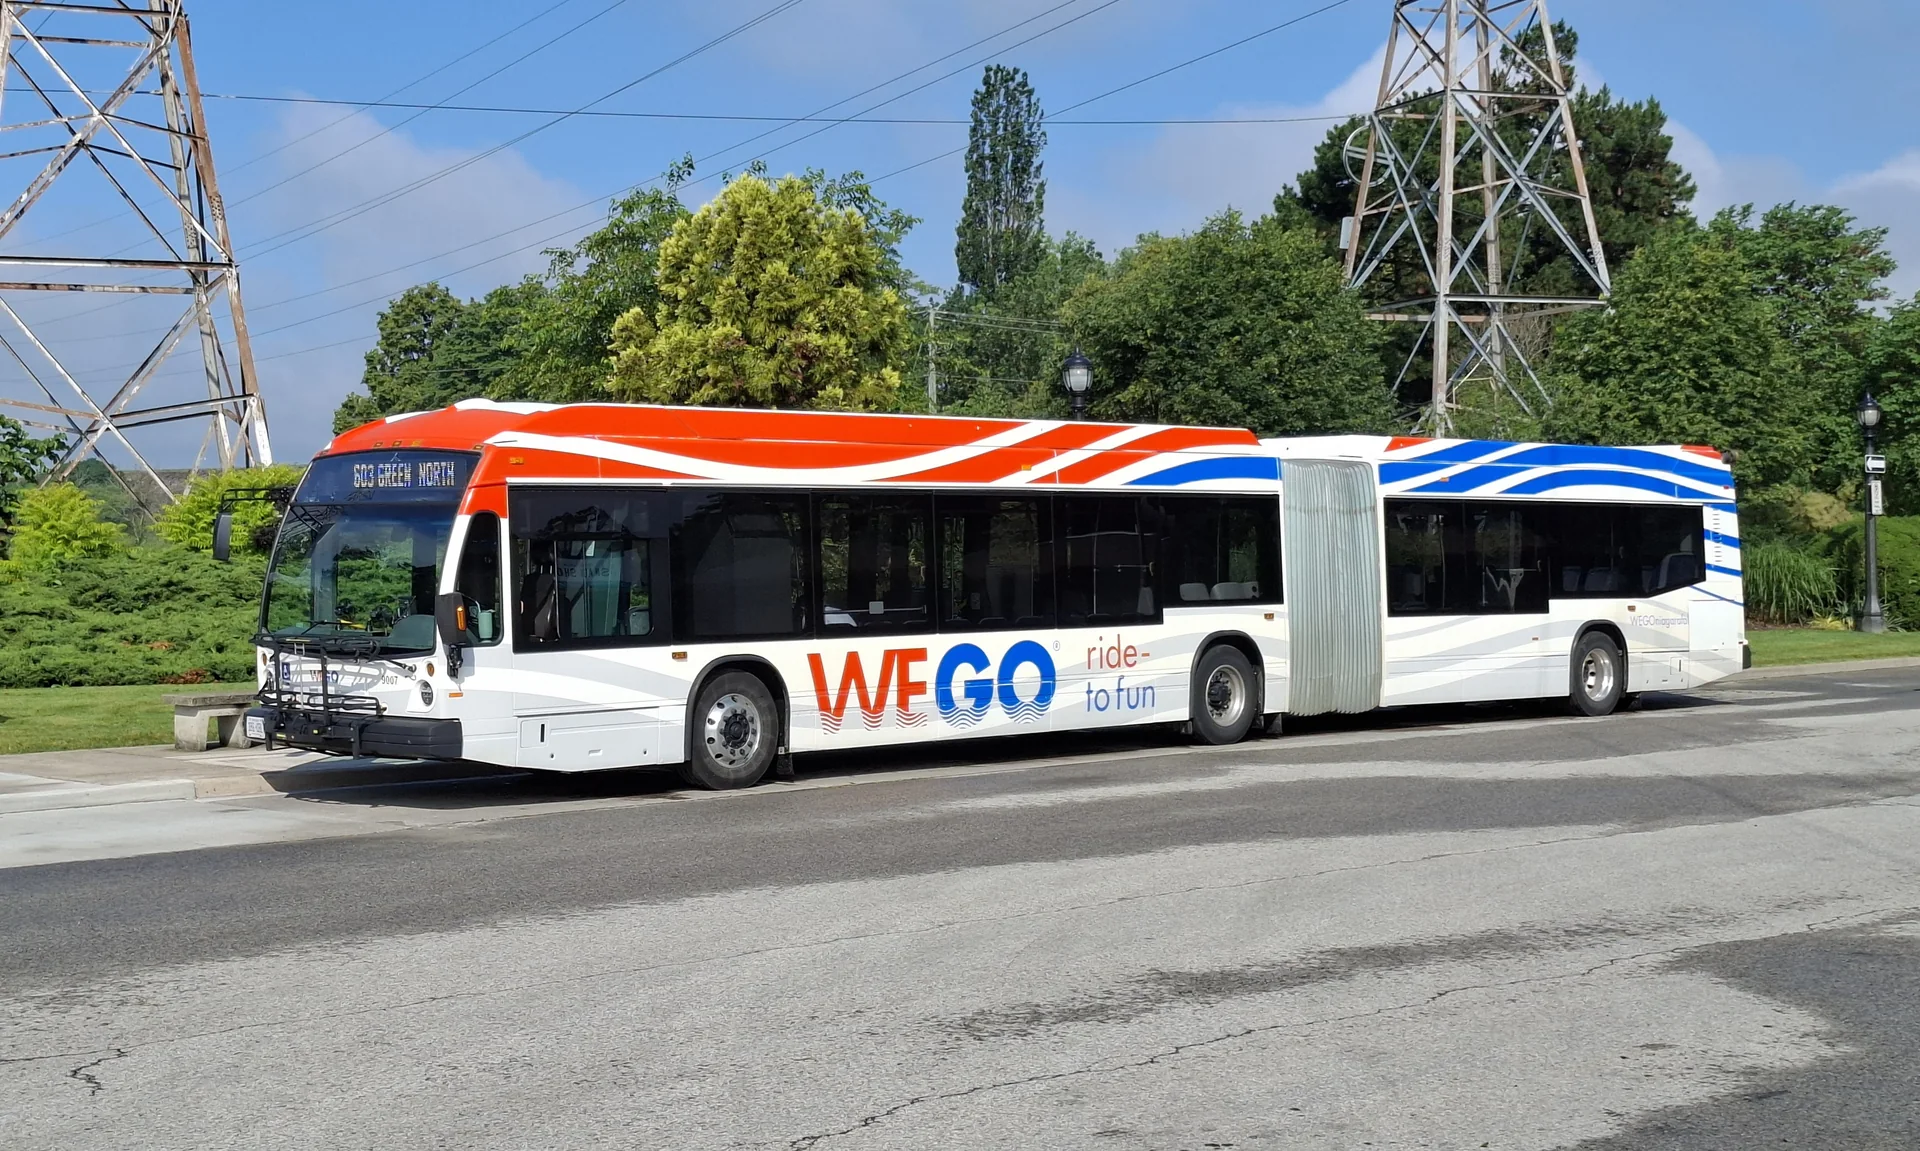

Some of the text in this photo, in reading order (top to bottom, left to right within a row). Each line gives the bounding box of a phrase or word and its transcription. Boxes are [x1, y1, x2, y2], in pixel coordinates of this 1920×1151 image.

[353, 462, 455, 488] 603 GREEN NORTH
[1087, 634, 1151, 670] ride-
[381, 674, 399, 686] 9007
[807, 639, 1057, 735] WEGO
[1085, 675, 1156, 712] to fun
